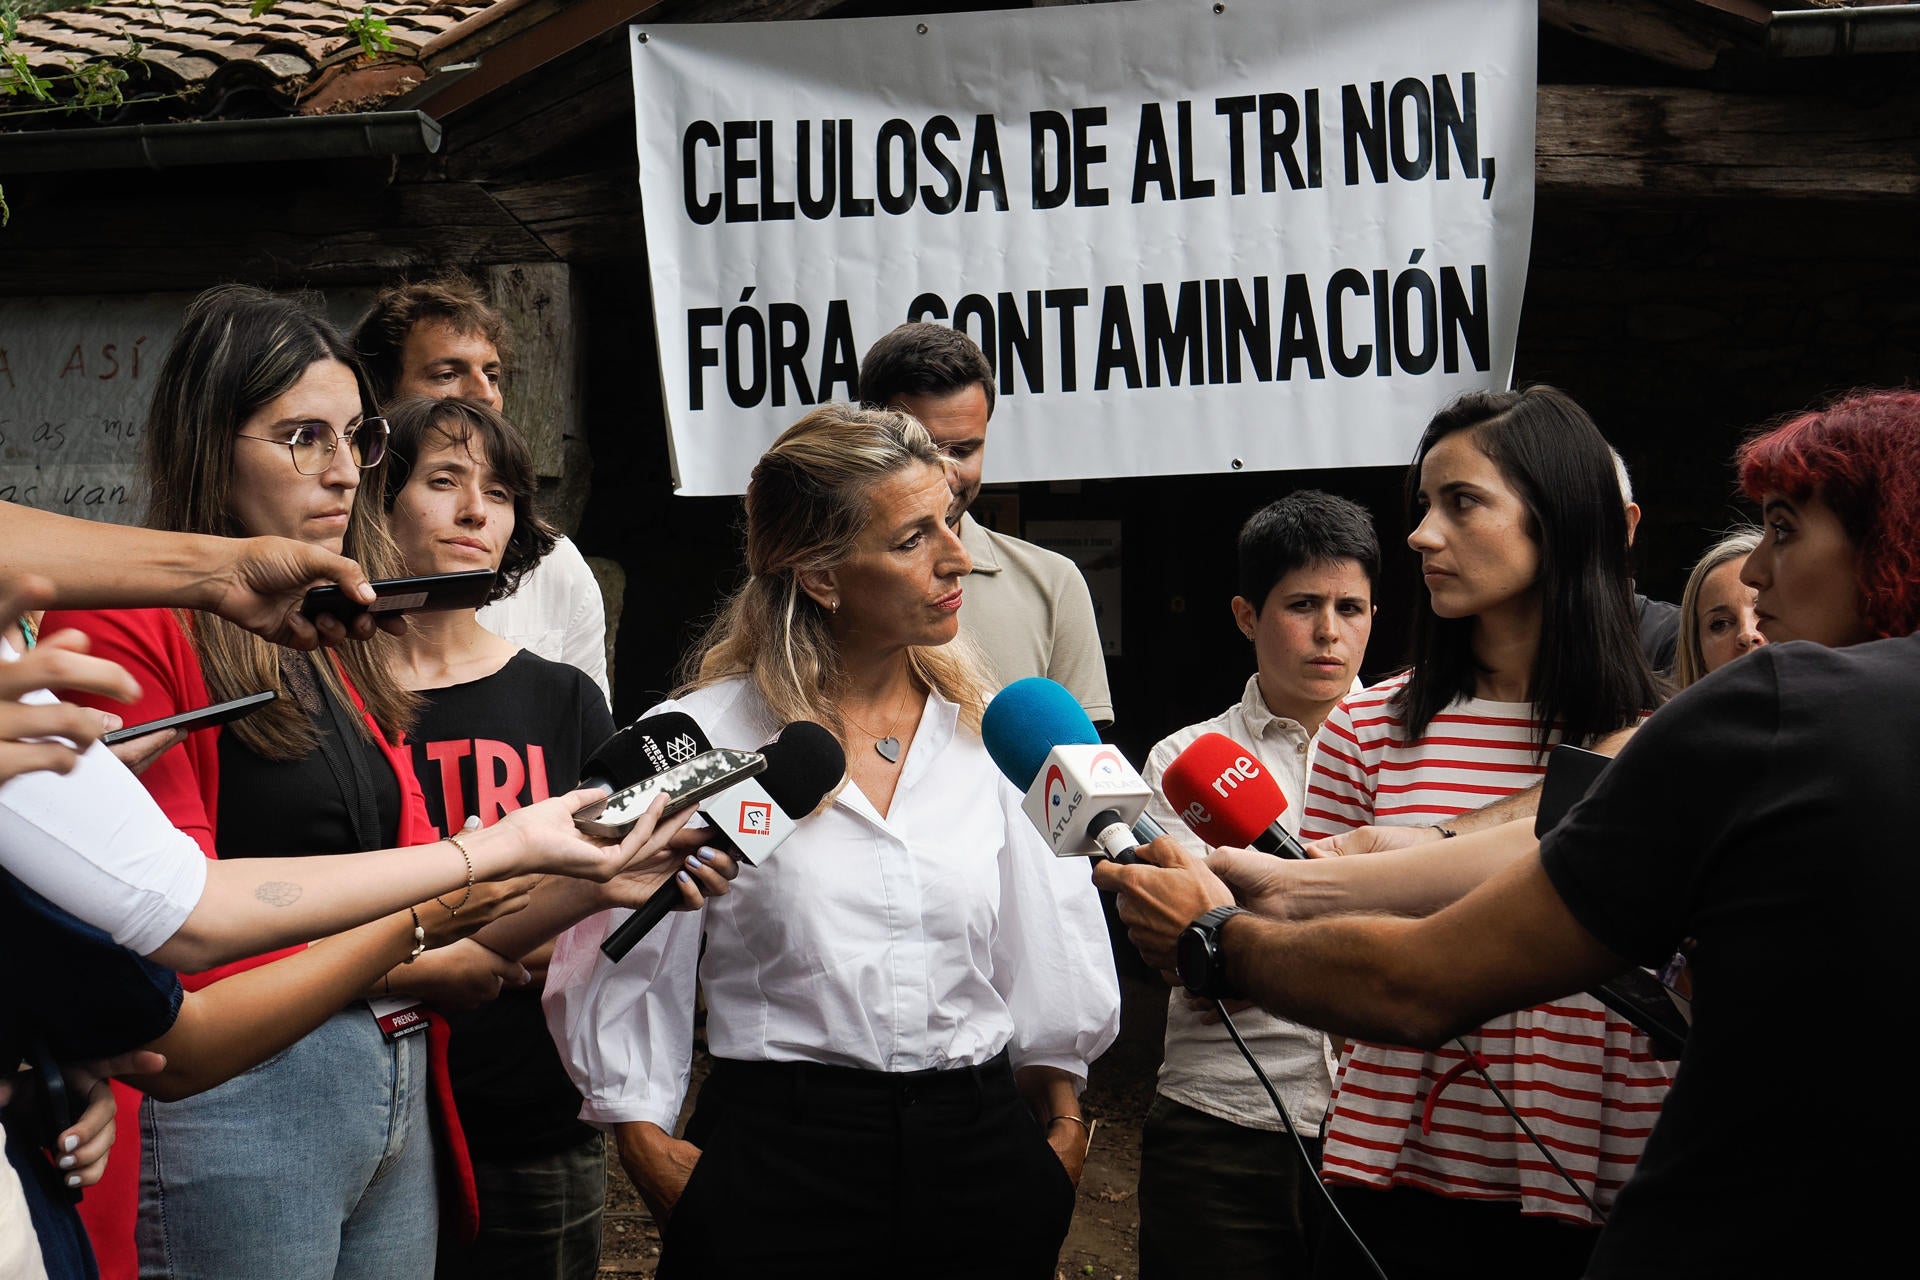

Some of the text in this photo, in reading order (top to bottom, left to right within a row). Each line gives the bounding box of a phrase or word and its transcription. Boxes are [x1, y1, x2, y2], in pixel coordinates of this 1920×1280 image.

[683, 72, 1496, 225] CELULOSA DE ALTRI NON,
[60, 336, 147, 381] ASÍ
[687, 286, 860, 411] FÓRA
[63, 484, 128, 506] van
[1094, 780, 1142, 789] ATLAS
[1211, 756, 1260, 799] rne
[1052, 791, 1083, 844] ATLAS
[1180, 801, 1212, 828] ne
[392, 1011, 420, 1028] PRENSA
